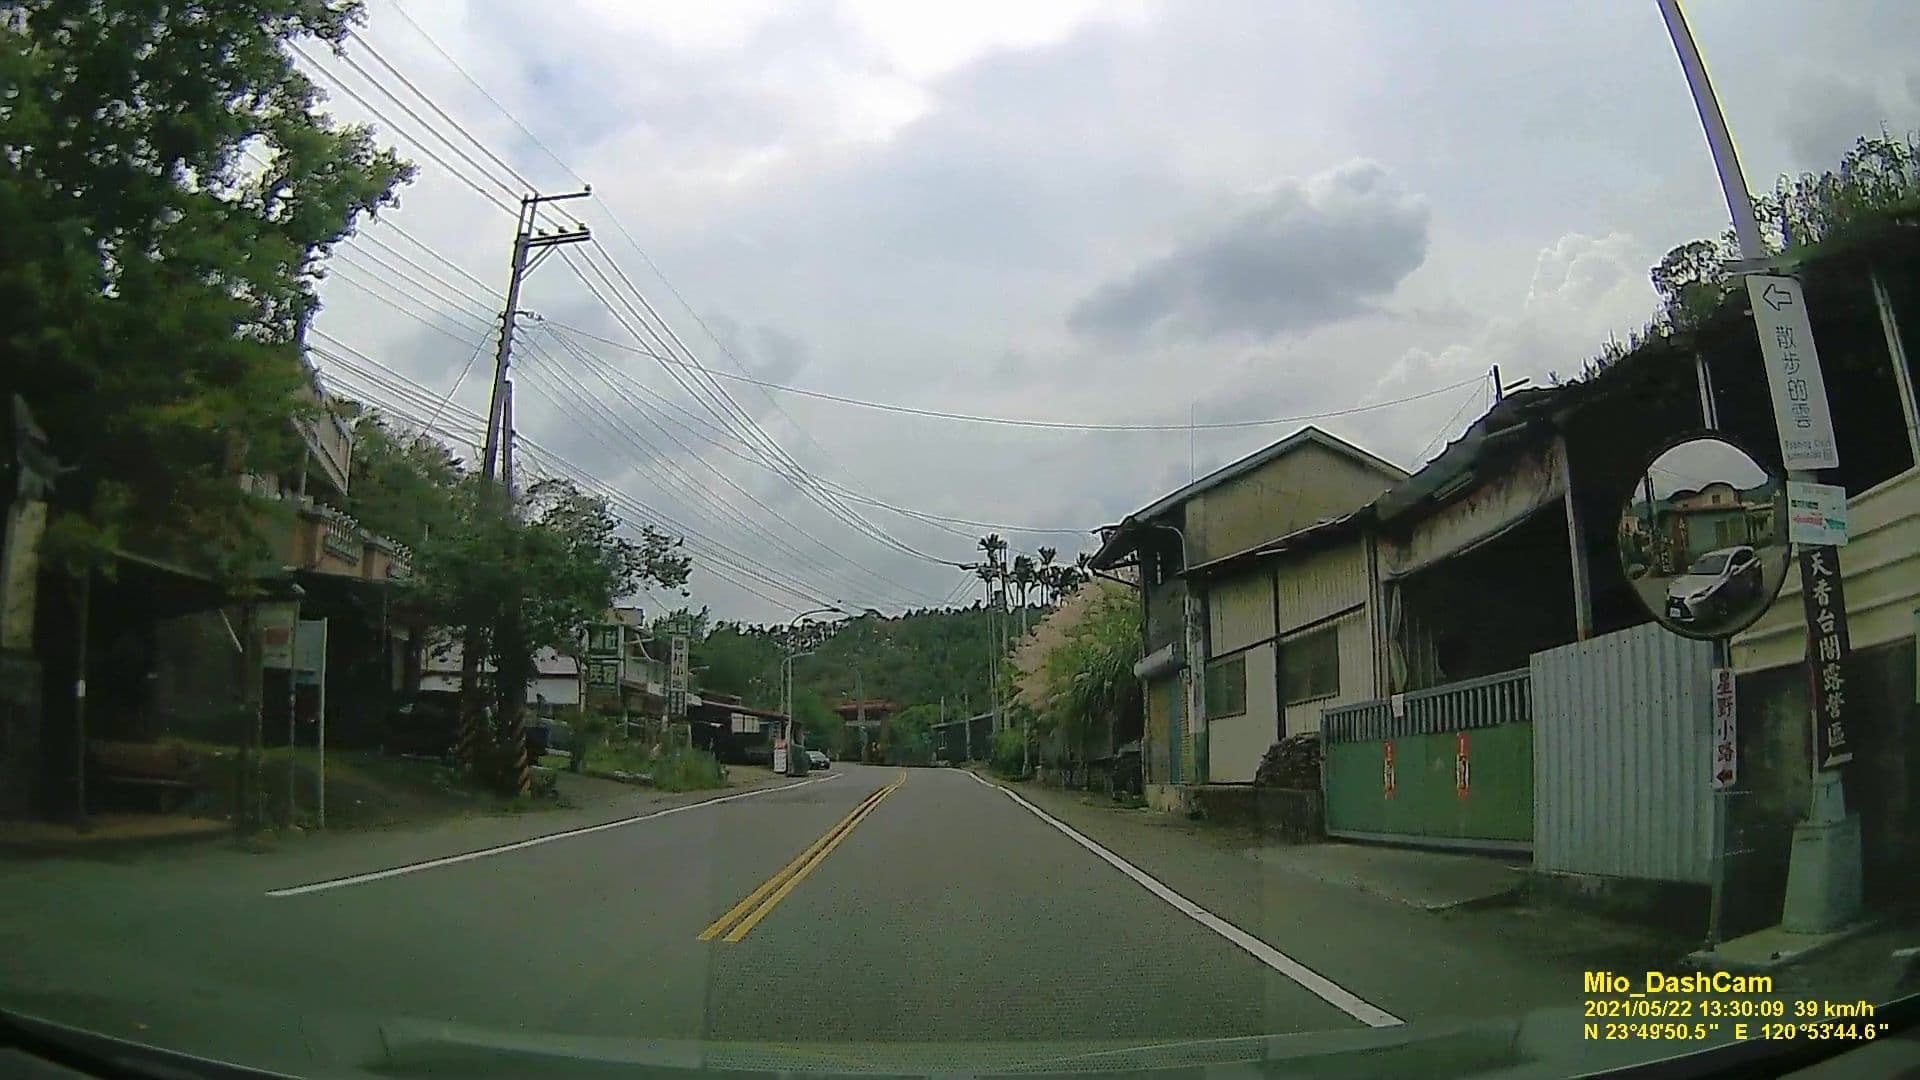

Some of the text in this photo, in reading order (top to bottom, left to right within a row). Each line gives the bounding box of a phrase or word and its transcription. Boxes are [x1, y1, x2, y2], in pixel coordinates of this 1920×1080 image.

[1775, 325, 1813, 429] 散步的雲
[1716, 671, 1734, 763] 星野小路
